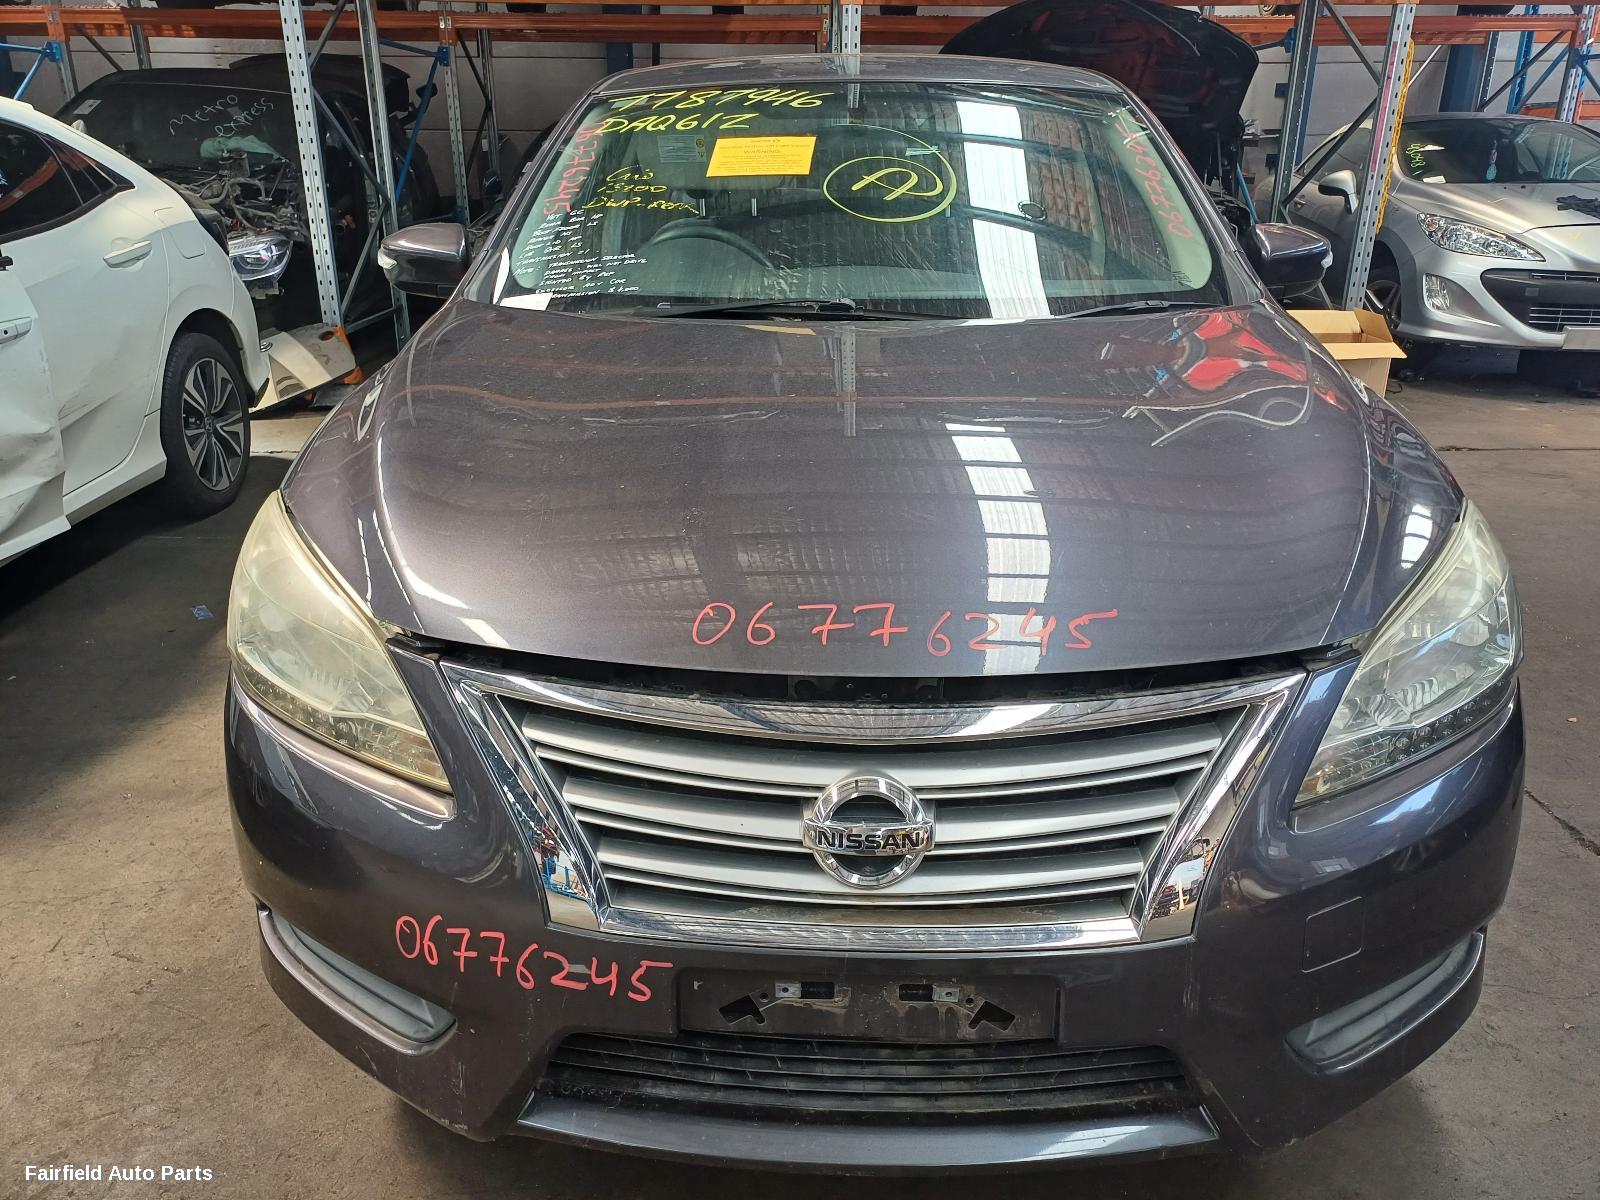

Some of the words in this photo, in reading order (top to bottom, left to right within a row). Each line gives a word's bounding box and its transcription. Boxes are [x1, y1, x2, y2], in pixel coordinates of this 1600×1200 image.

[692, 602, 1119, 656] 06776245
[816, 830, 923, 853] NISSAN
[394, 913, 675, 1003] 06776245
